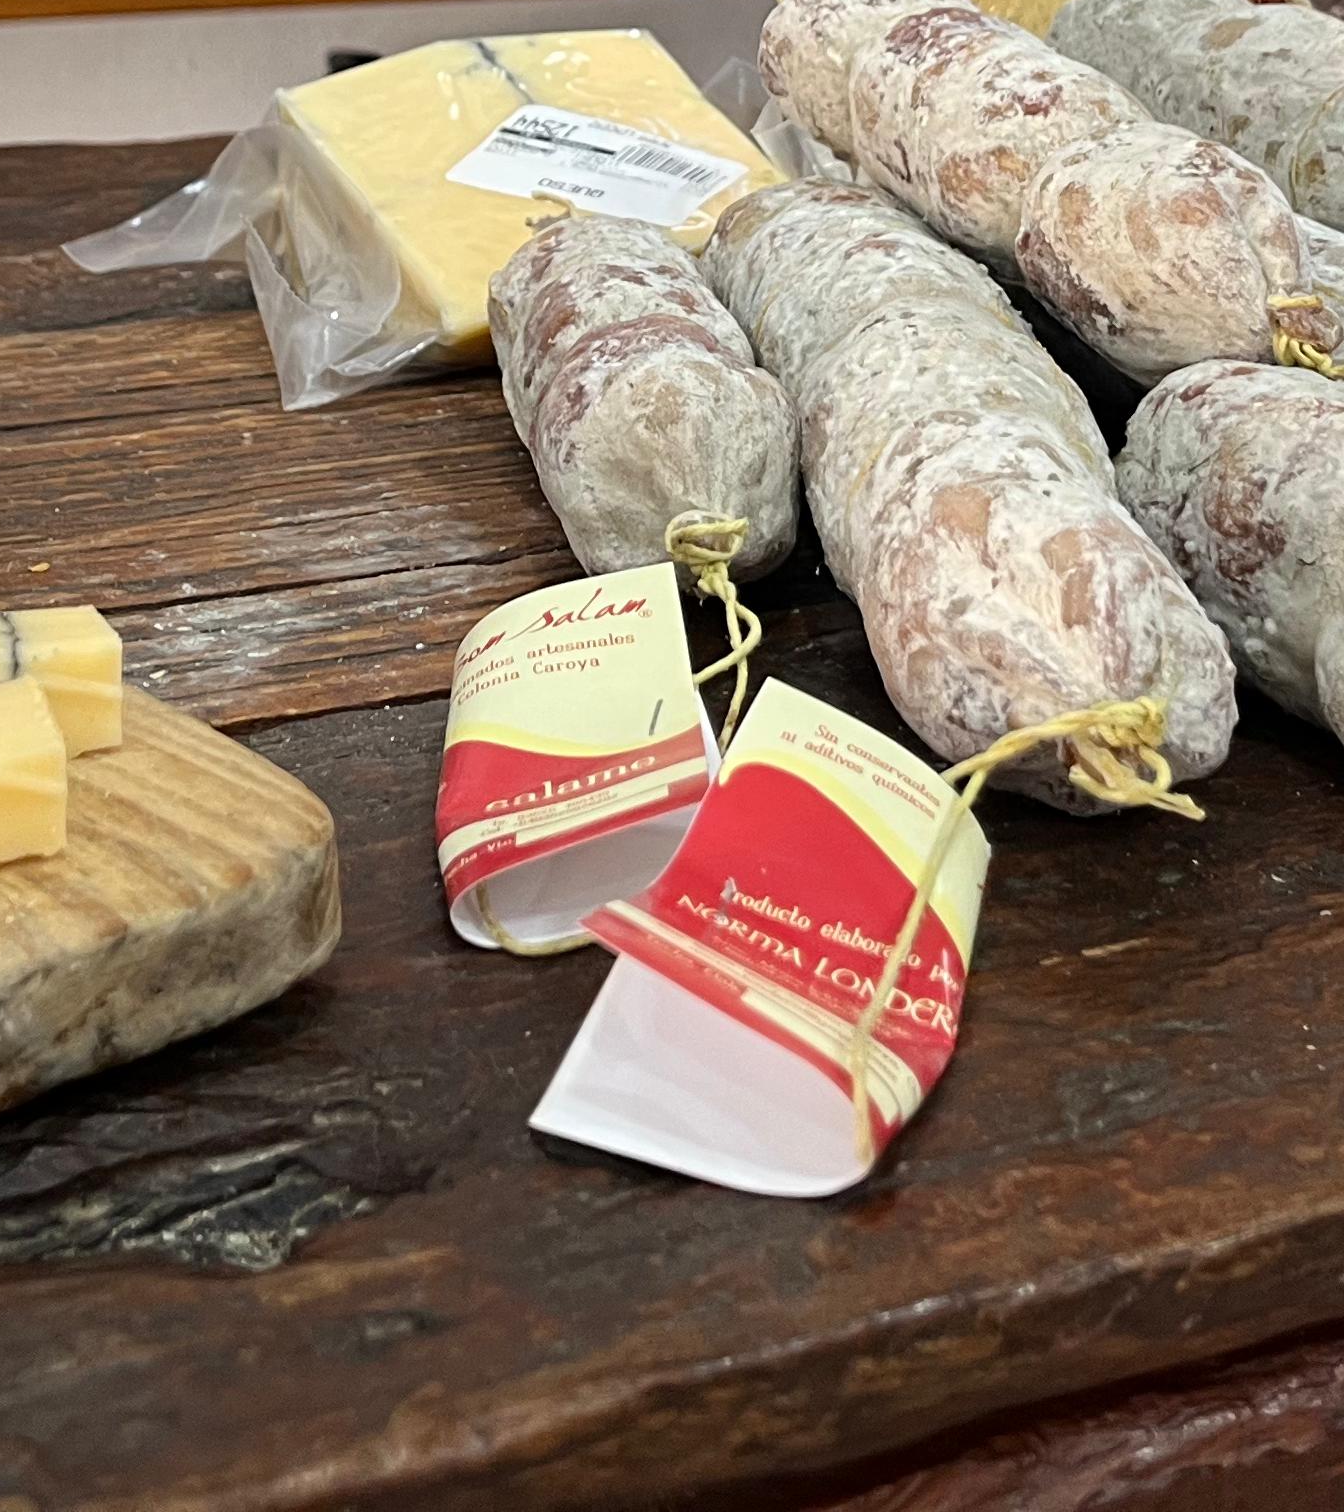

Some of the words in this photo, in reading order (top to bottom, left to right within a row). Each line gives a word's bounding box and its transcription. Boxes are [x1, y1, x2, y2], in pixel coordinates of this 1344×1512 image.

[537, 177, 605, 198] QUESO
[527, 633, 635, 659] artesanales
[532, 656, 600, 675] Caroya
[780, 729, 797, 743] ni
[804, 739, 864, 775] aditivos
[814, 724, 839, 745] Sin
[847, 742, 940, 807] conservantes
[677, 894, 803, 968] NORMA
[814, 957, 957, 1037] LONDER
[820, 922, 921, 968] elaborao
